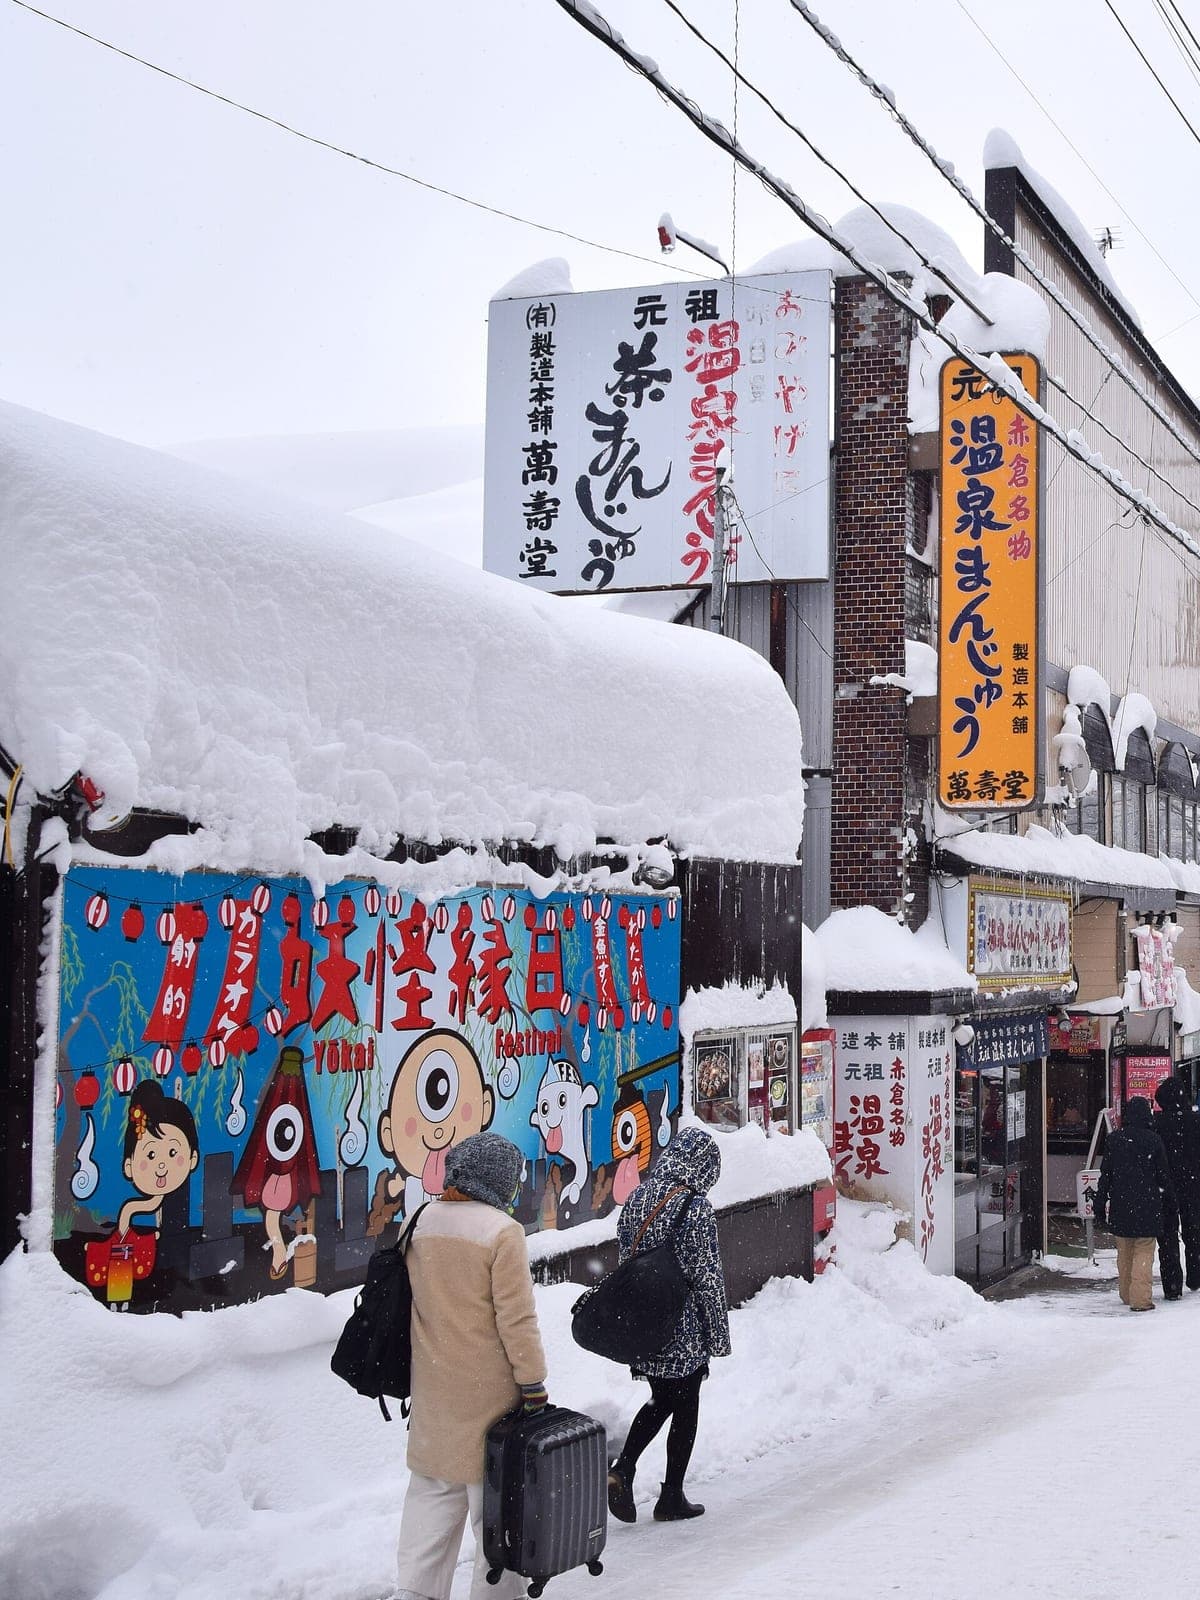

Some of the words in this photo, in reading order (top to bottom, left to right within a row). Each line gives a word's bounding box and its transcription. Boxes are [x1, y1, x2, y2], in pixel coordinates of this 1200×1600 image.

[634, 289, 719, 330] 元祖
[575, 332, 673, 590] 茶まんじゅう
[1007, 413, 1032, 560] 赤倉名物
[950, 415, 1012, 758] 温泉まんじゅう
[1012, 643, 1029, 735] 製造本舗
[163, 933, 196, 1020] 射的
[217, 906, 256, 1043] カラオケ
[279, 915, 564, 1037] 妖怪縁日
[495, 1024, 563, 1059] Festival
[842, 1032, 906, 1050] 造本舗
[845, 1063, 885, 1081] 元祖
[928, 1057, 942, 1078] 元祖
[850, 1095, 890, 1180] 温泉
[889, 1056, 906, 1147] 赤倉名物
